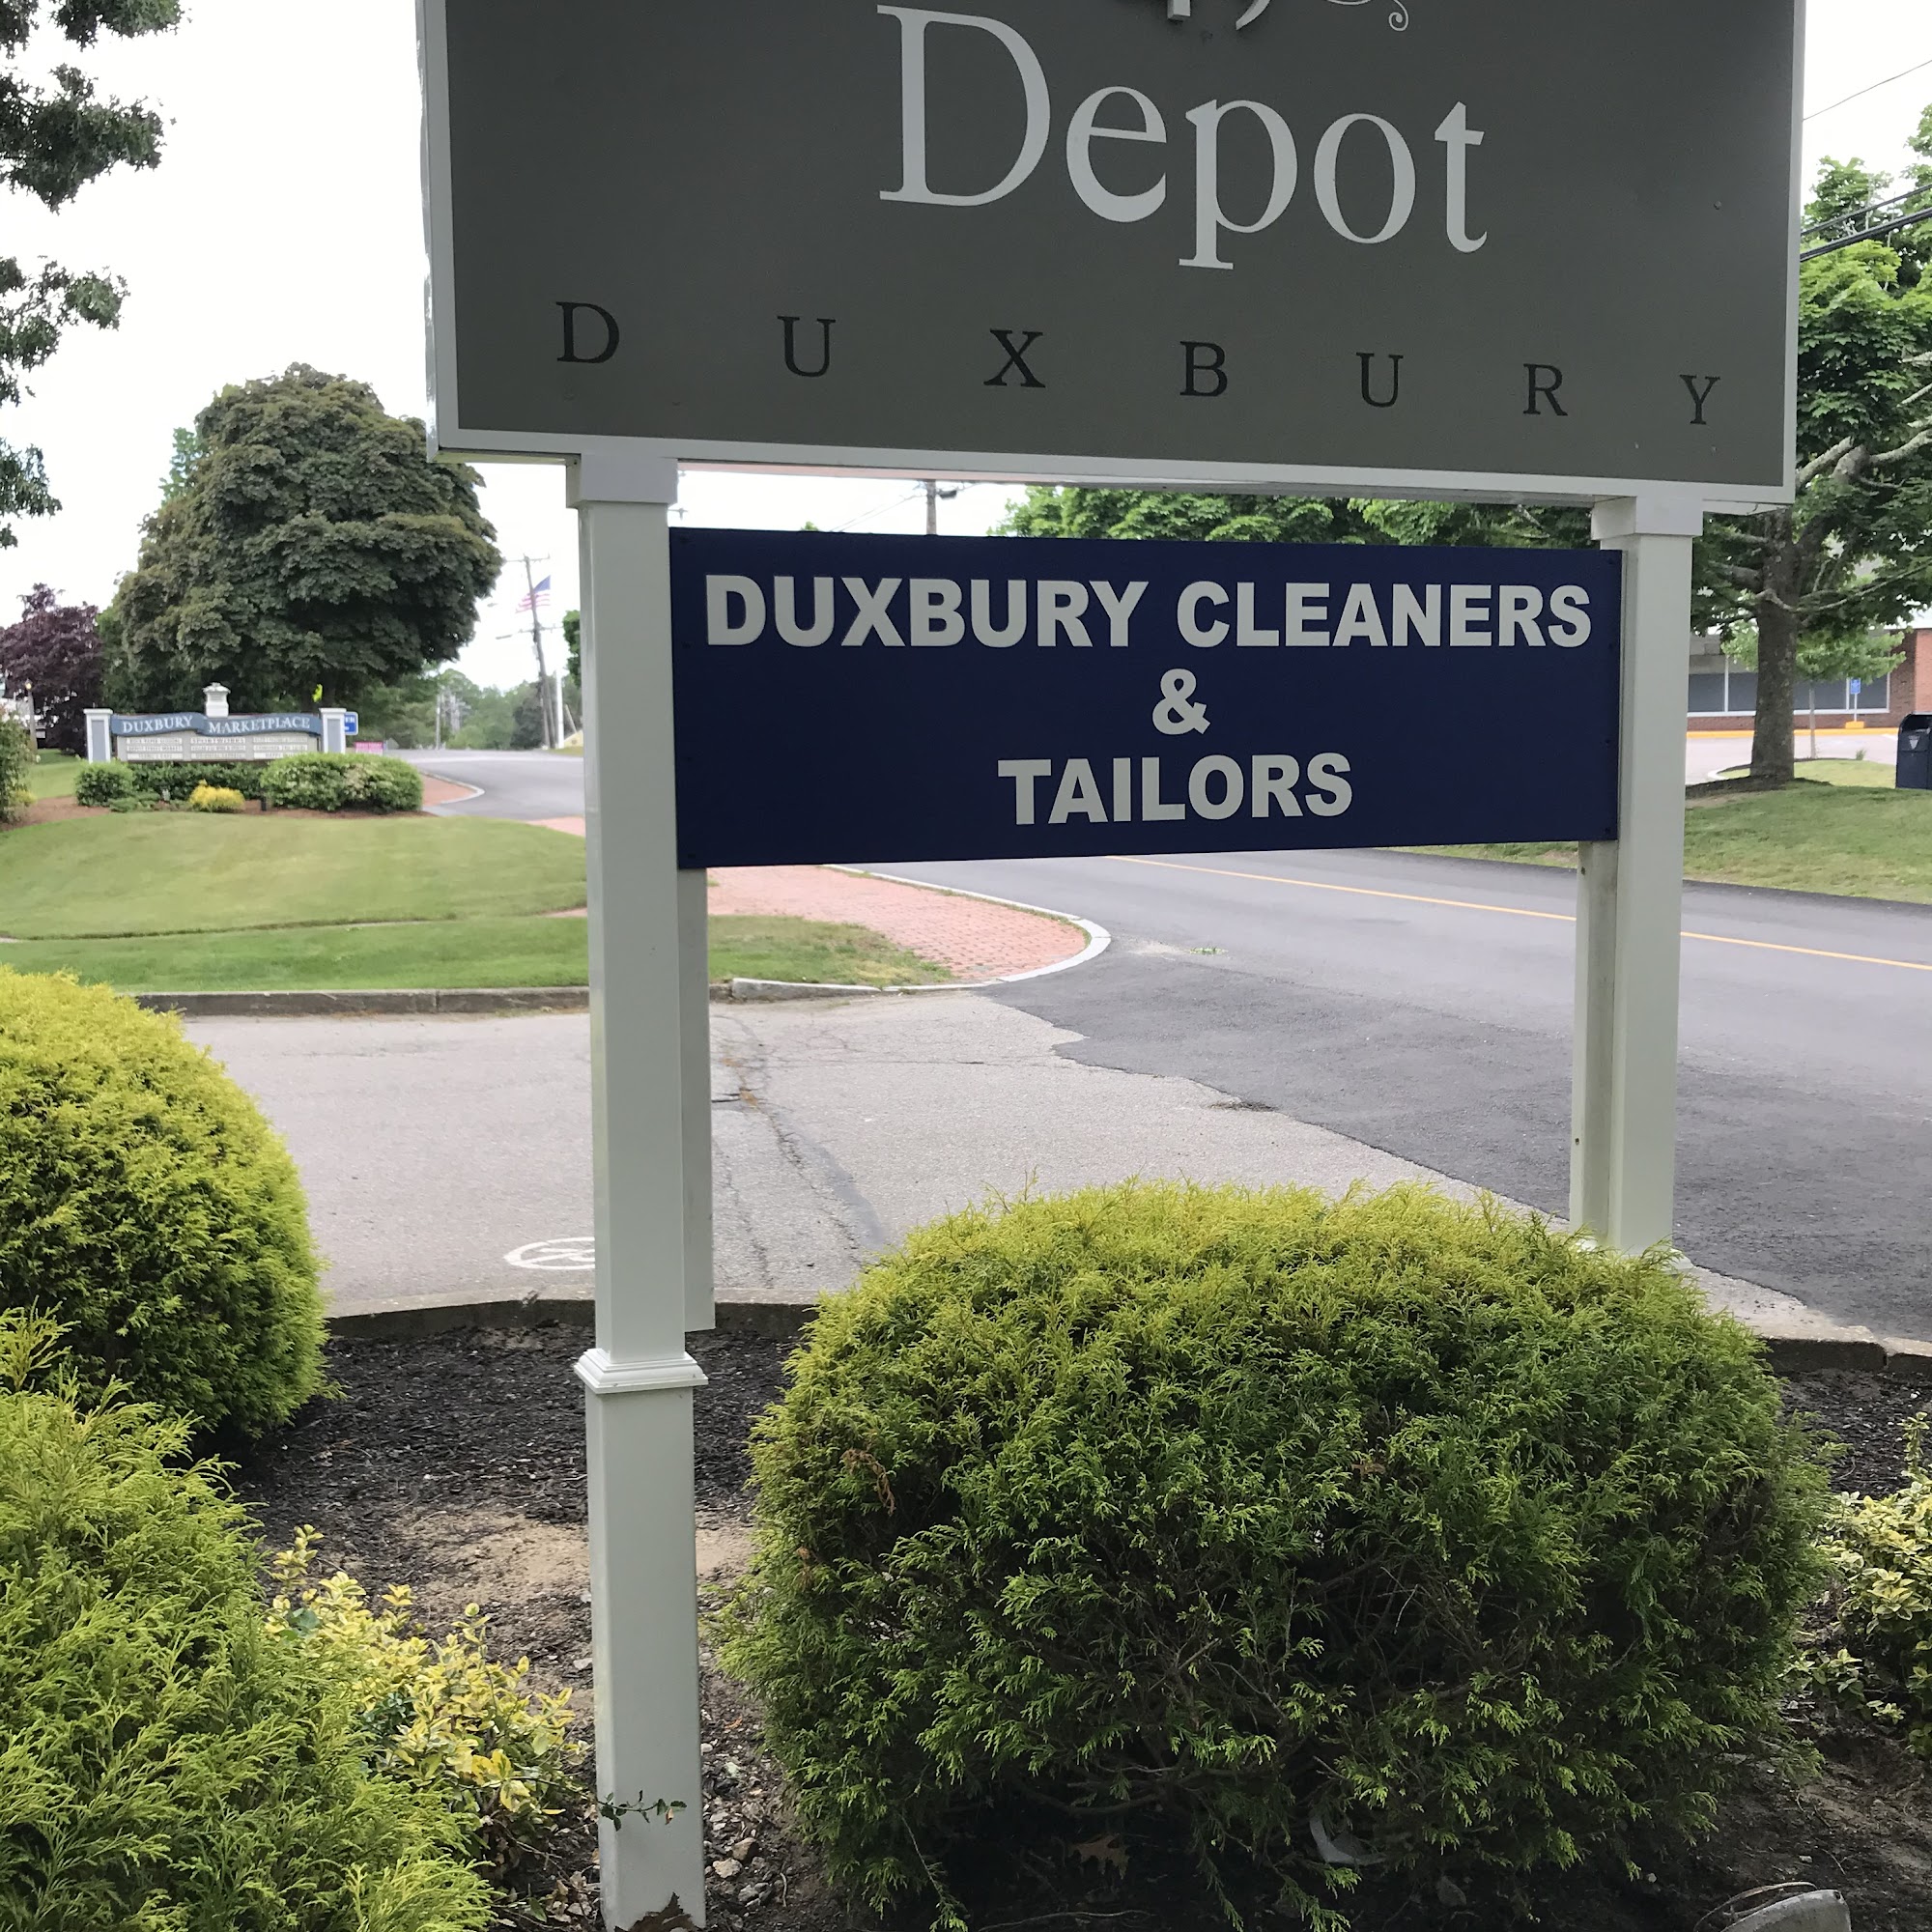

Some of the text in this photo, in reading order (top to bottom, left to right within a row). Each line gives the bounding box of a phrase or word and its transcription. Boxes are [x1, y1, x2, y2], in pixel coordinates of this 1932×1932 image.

[876, 3, 1490, 271] Depot
[554, 300, 1722, 425] DUXBURY
[704, 573, 1592, 649] DUXBURY CLEANERS
[122, 715, 310, 734] DUXBURY MARKETPLACE
[1151, 668, 1212, 736] &
[996, 752, 1353, 826] TAILORS
